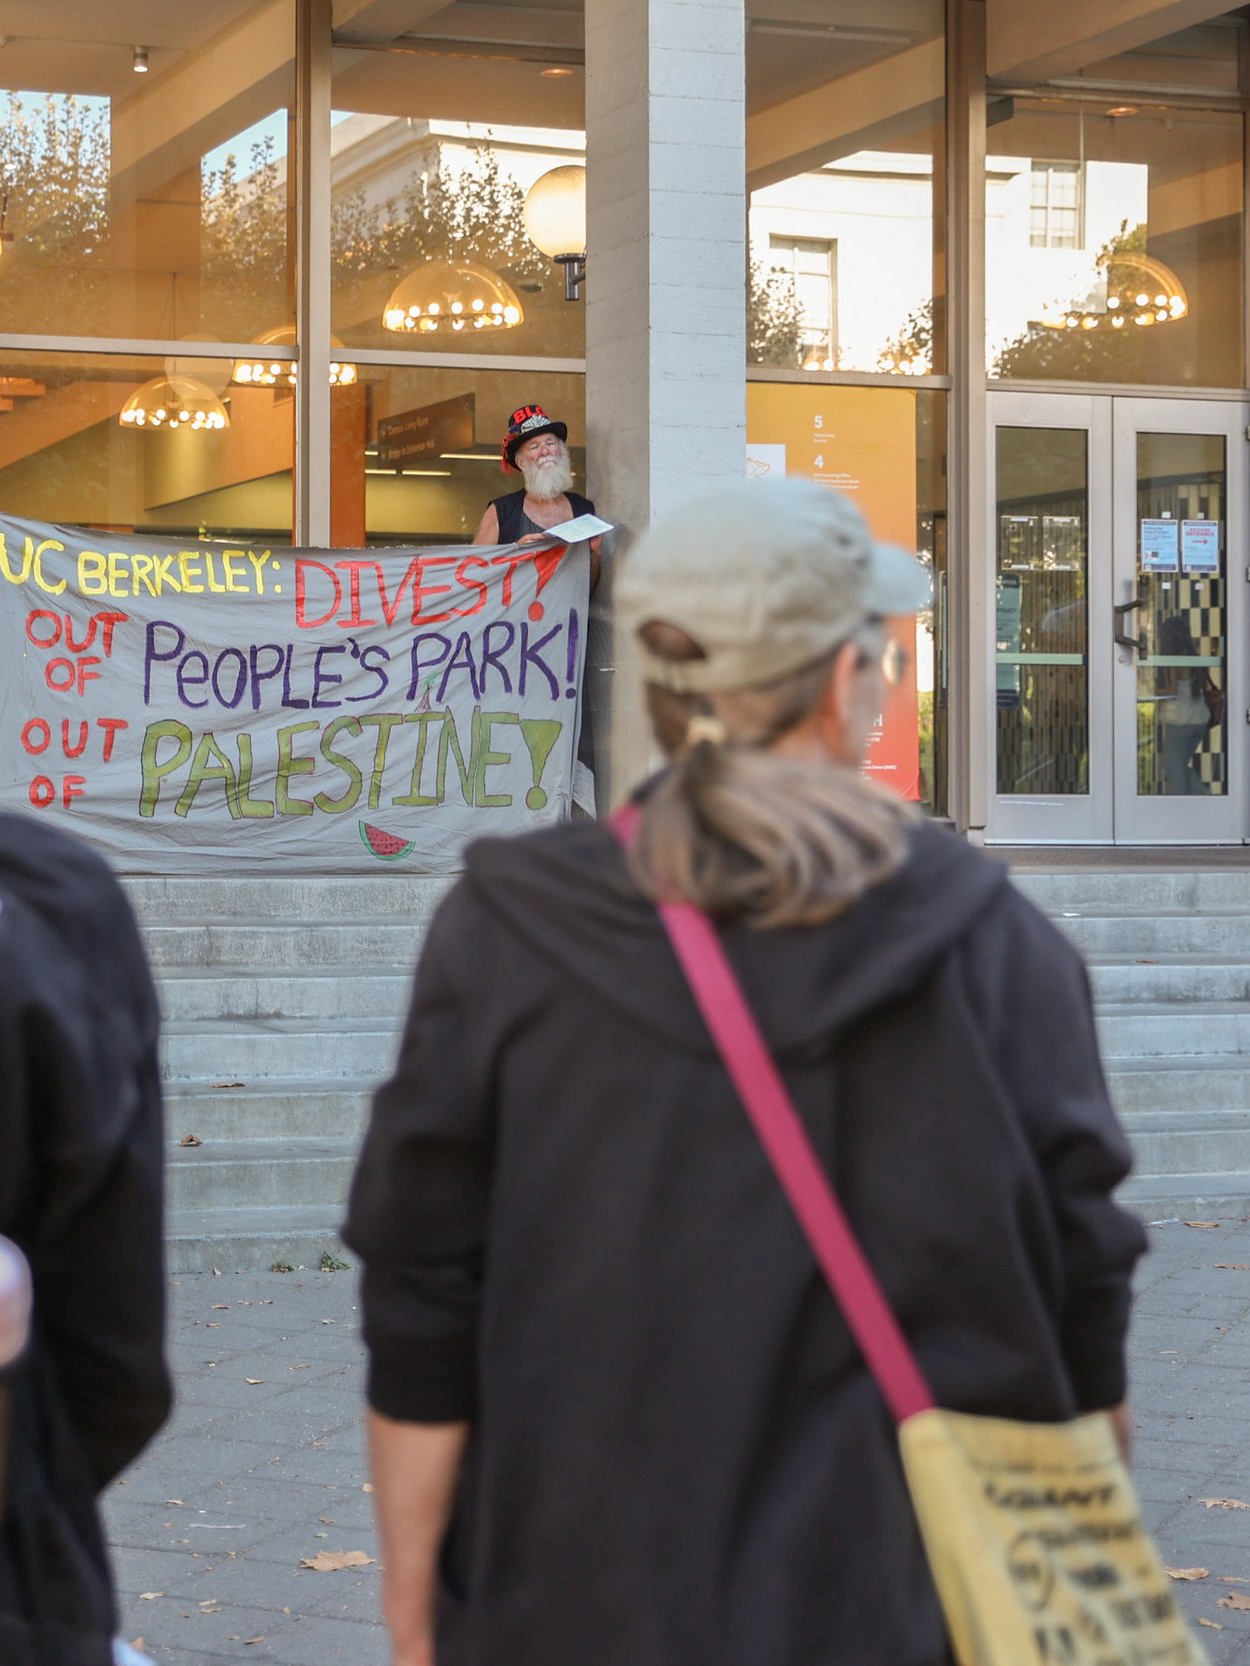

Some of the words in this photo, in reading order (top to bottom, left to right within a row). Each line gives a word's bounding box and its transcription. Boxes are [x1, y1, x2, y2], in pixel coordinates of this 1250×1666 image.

[813, 415, 823, 429] 5
[813, 454, 824, 469] 4
[78, 549, 282, 597] BERKELEY:
[296, 545, 567, 628] DIVEST!
[26, 610, 128, 659] OUT
[408, 608, 578, 702] PARK!
[45, 657, 101, 695] OF
[21, 718, 128, 761] OUT
[139, 706, 562, 820] PALESTINE!
[29, 775, 86, 808] OF
